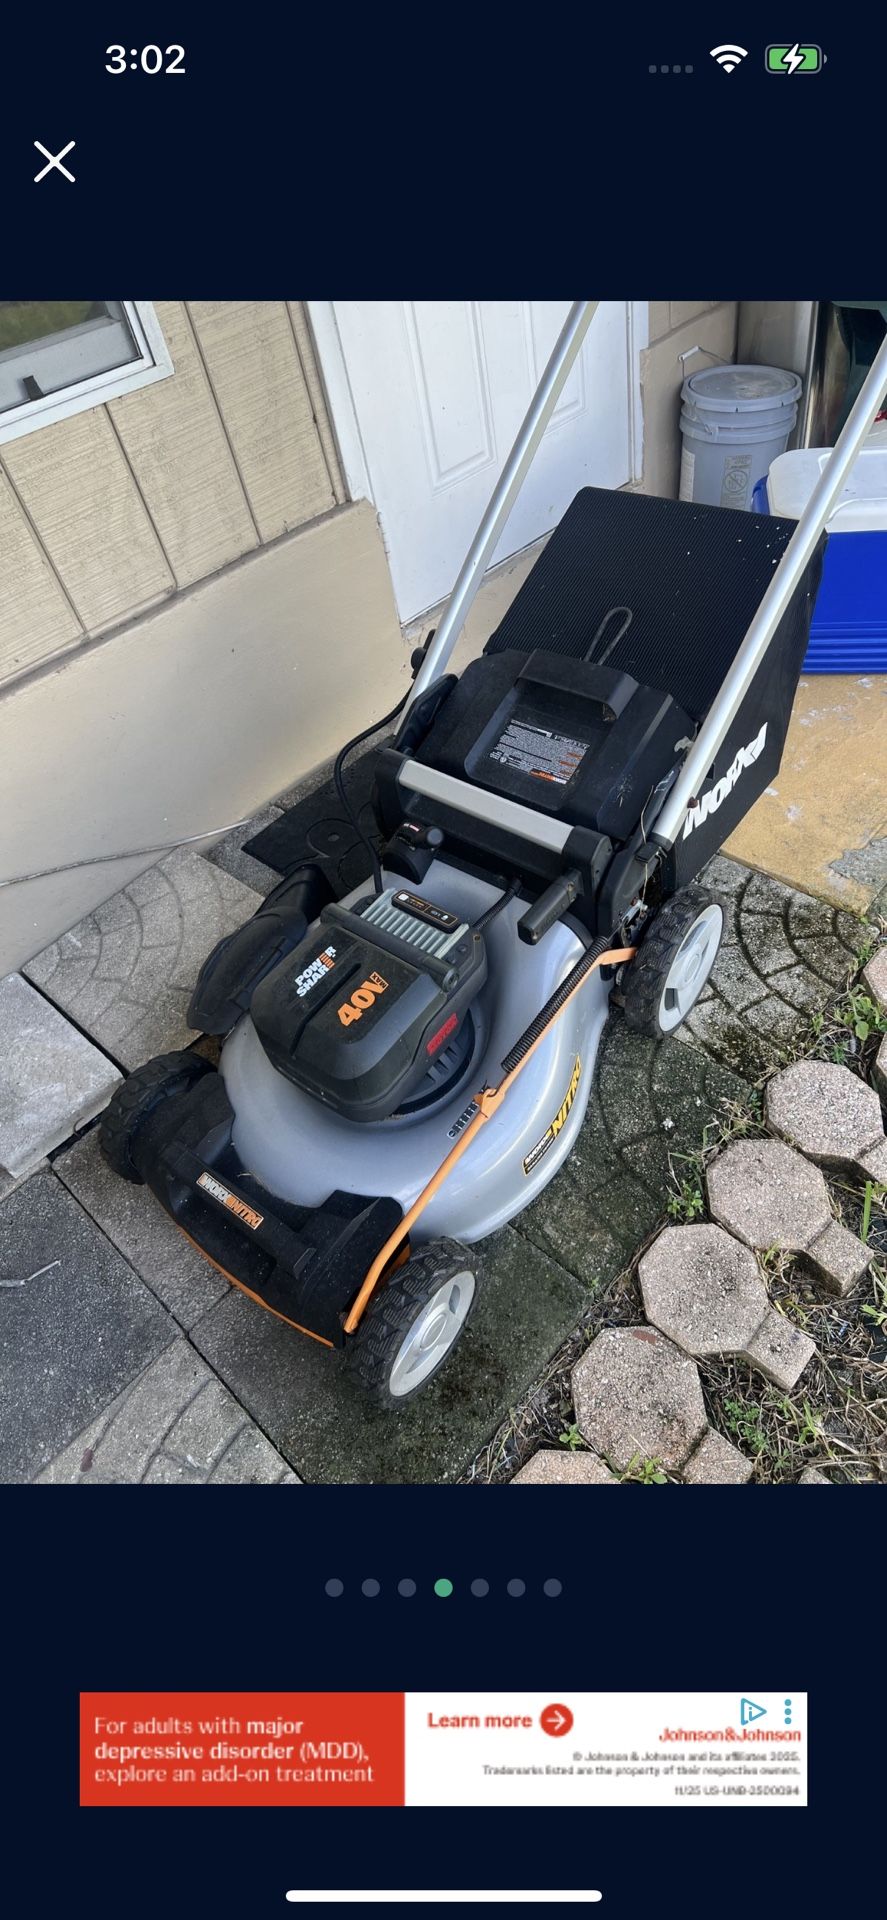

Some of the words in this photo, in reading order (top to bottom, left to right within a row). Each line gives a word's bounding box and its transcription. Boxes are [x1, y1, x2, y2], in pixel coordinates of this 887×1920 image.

[105, 44, 186, 74] 3:02
[682, 722, 767, 840] WORX
[294, 946, 337, 986] POWER
[296, 960, 336, 997] SHARE
[337, 980, 385, 1027] 40V
[369, 971, 389, 992] MAX
[203, 1174, 229, 1202] WORX
[229, 1198, 262, 1227] NITRO
[94, 1717, 127, 1734] For
[133, 1716, 193, 1734] adults
[198, 1716, 241, 1734] with
[246, 1716, 304, 1738] major
[427, 1711, 480, 1729] Learn
[484, 1715, 533, 1729] more
[658, 1727, 802, 1743] Johnson&Johnson
[94, 1741, 203, 1763] depressive
[209, 1741, 294, 1760] disorder
[299, 1741, 369, 1763] (MDD),
[584, 1751, 628, 1762] Johnson
[630, 1751, 640, 1762] &
[641, 1751, 686, 1762] Johnson
[688, 1751, 708, 1762] and
[709, 1751, 723, 1762] its
[94, 1764, 167, 1786] explore
[172, 1768, 196, 1782] an
[201, 1764, 270, 1782] add-on
[276, 1765, 374, 1782] treatment
[483, 1764, 544, 1775] Trademarks
[545, 1764, 574, 1775] listed
[576, 1767, 594, 1775] are
[595, 1765, 613, 1775] the
[615, 1766, 660, 1777] property
[662, 1764, 675, 1775] of
[676, 1764, 701, 1775] their
[702, 1765, 758, 1777] respective
